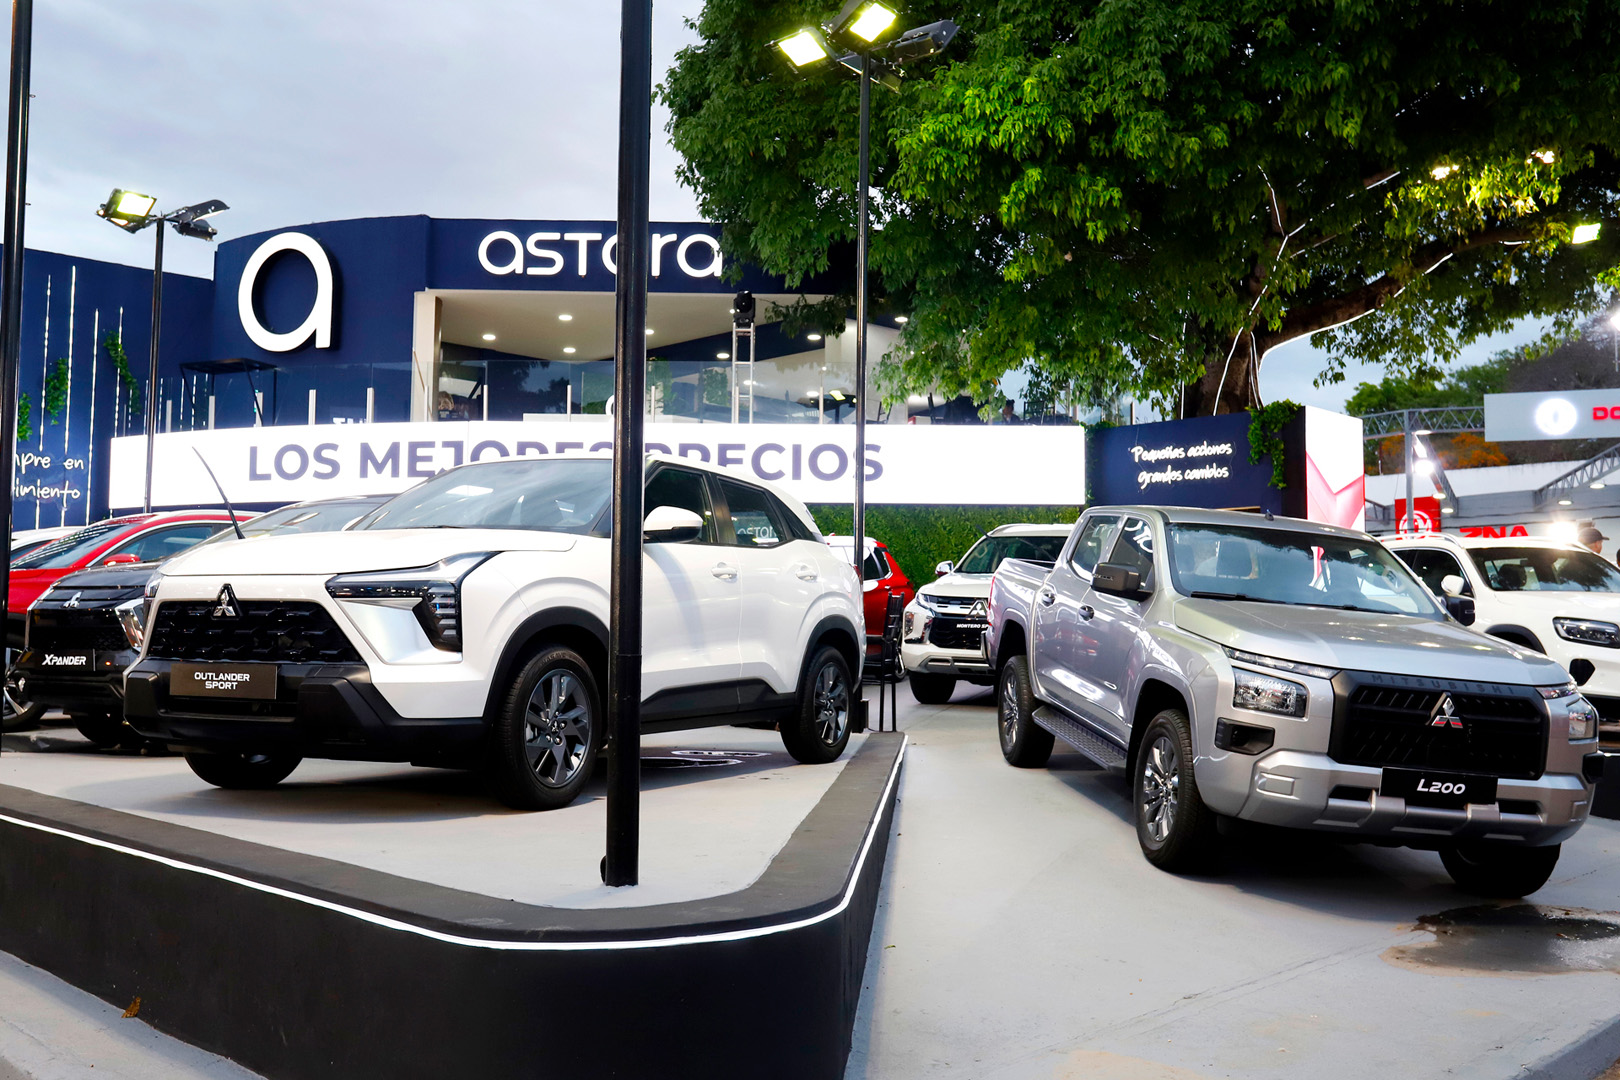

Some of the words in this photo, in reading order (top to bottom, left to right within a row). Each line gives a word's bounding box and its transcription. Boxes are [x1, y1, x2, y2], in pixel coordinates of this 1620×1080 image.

[63, 459, 84, 470] en
[249, 443, 341, 481] LOS
[1138, 465, 1183, 490] grandes
[1184, 463, 1229, 480] cambios
[41, 653, 87, 666] XPANDER
[194, 671, 250, 682] OUTLANDER
[205, 681, 238, 690] SPORT
[1371, 674, 1515, 695] MITSUBISHI
[1416, 778, 1466, 795] L200
